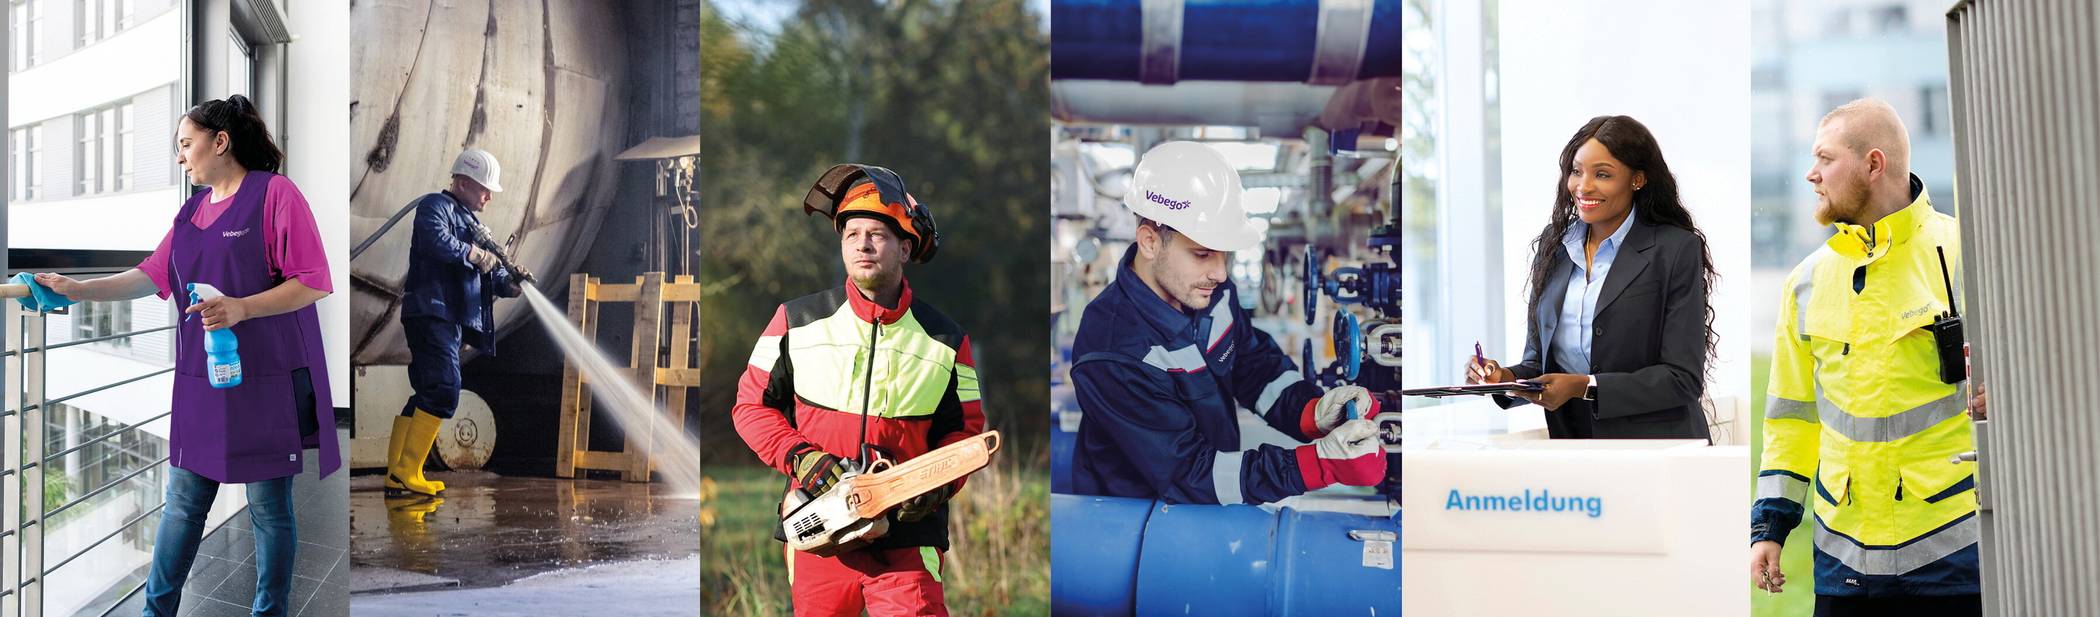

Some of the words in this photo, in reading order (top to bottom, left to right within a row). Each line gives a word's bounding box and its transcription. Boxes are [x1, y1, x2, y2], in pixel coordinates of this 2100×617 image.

[1145, 190, 1183, 210] Vebego
[1218, 343, 1235, 362] Vebego
[1445, 489, 1602, 518] Anmeldung
